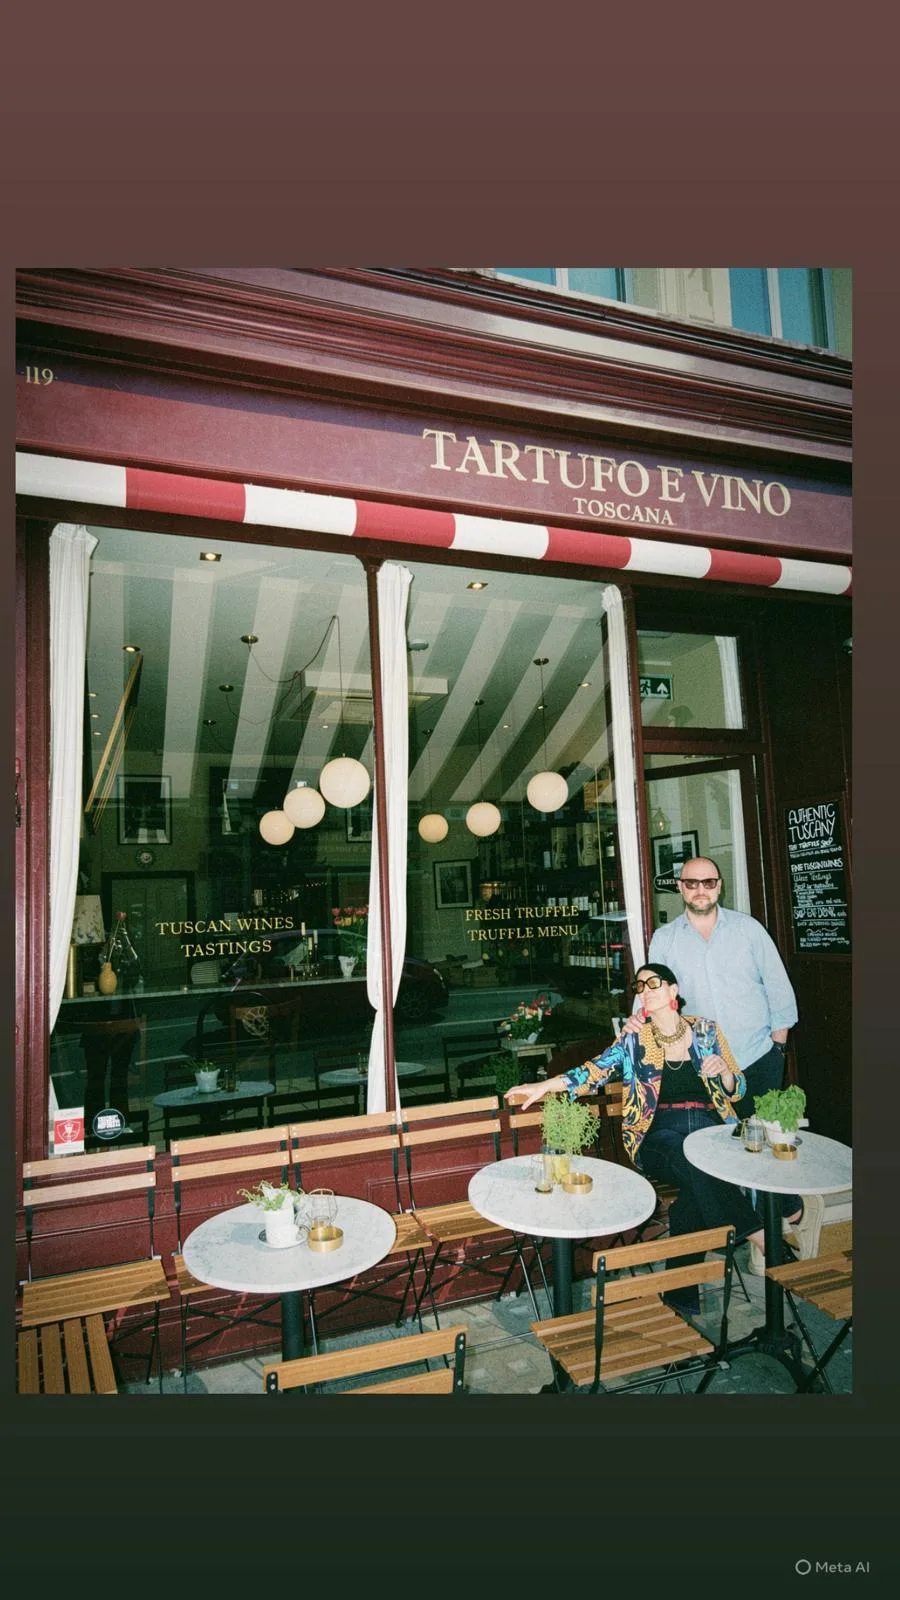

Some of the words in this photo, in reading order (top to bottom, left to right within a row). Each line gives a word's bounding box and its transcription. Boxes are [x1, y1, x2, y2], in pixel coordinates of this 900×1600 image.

[26, 366, 54, 386] 119
[422, 428, 650, 498] TARTUFO
[656, 465, 686, 503] E
[691, 470, 791, 517] VINO
[572, 497, 677, 526] TOSCANA
[788, 803, 835, 825] AUTHENTIC
[788, 817, 836, 842] TUSCANY
[464, 908, 511, 921] FRESH
[514, 905, 579, 919] TRUFFLE
[155, 919, 232, 935] TUSCAN
[236, 916, 294, 931] WINES
[467, 926, 535, 941] TRUFFLE
[537, 924, 579, 938] MENU
[180, 940, 272, 958] TASTINGS
